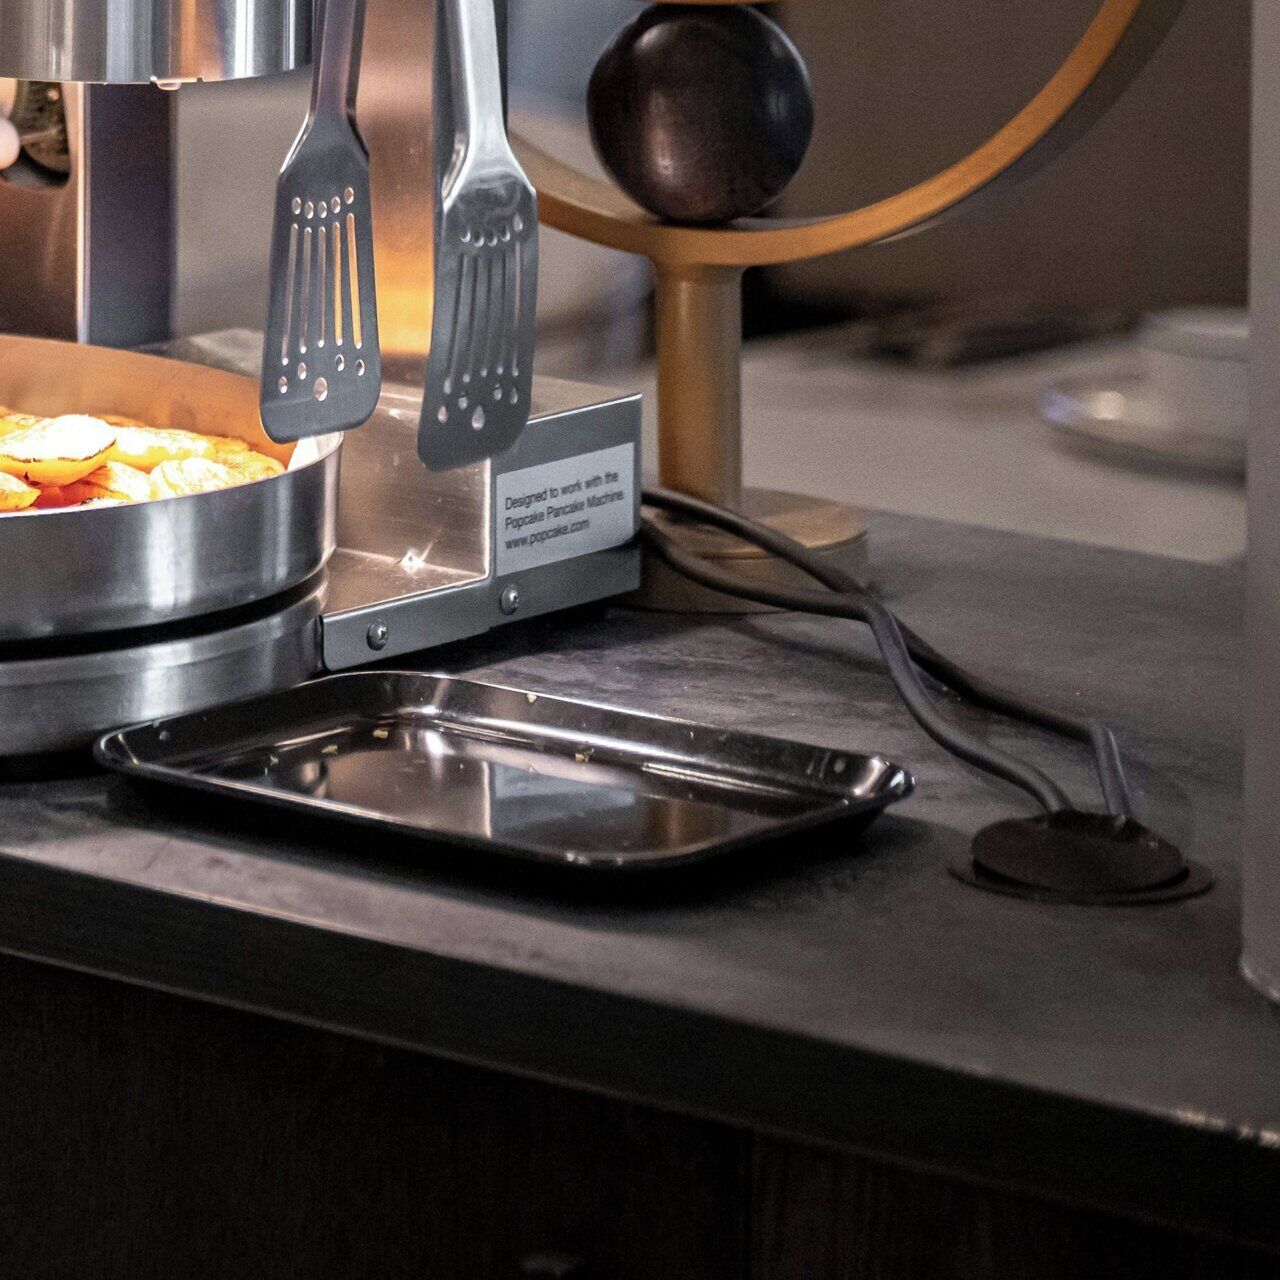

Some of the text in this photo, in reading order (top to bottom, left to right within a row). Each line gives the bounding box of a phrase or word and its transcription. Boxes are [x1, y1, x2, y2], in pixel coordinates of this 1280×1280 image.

[505, 472, 618, 509] Designed to work with the
[505, 511, 545, 530] Popcake
[546, 501, 585, 518] Pancake
[504, 519, 589, 550] www.popcake.com
